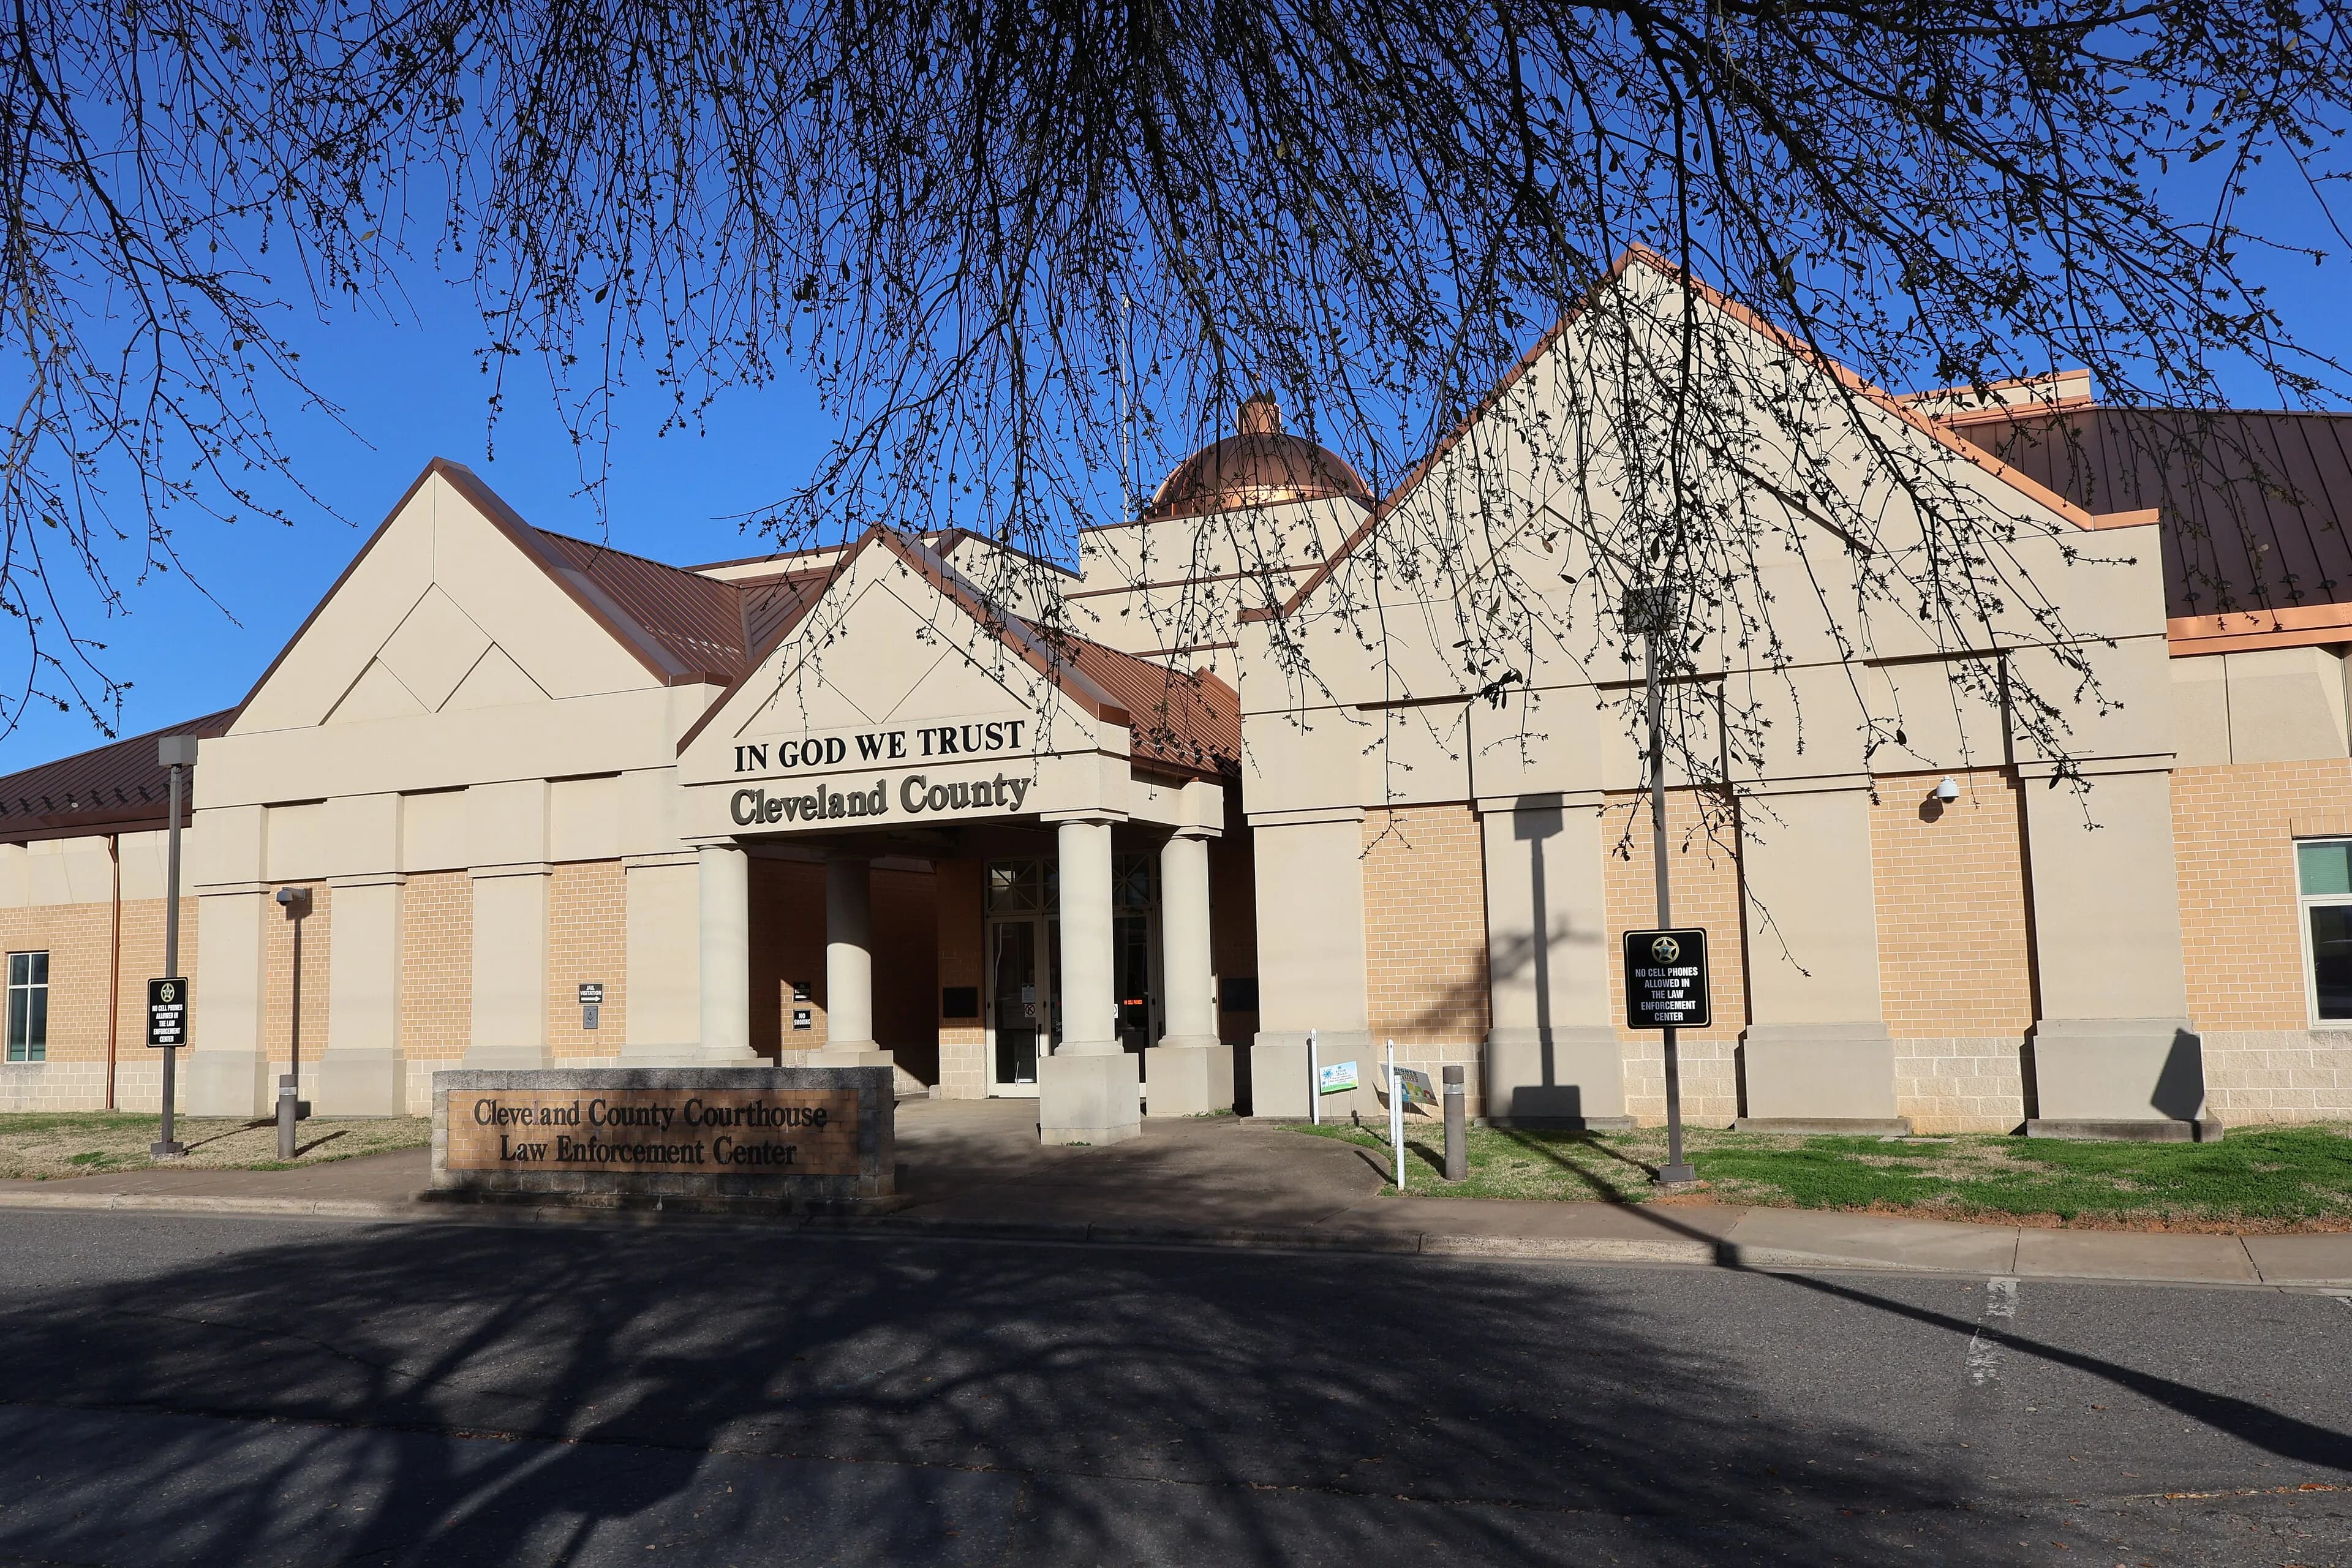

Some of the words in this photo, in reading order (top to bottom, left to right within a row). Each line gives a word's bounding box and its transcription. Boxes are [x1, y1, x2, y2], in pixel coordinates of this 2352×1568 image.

[734, 744, 769, 772] IN
[778, 737, 846, 768] GOD
[855, 731, 907, 761] WE
[917, 720, 1025, 756] TRUST
[731, 778, 889, 826] Cleveland
[900, 772, 1031, 813] County
[1635, 968, 1646, 977] NO
[1648, 968, 1665, 977] CELL
[1667, 967, 1698, 976] PHONES
[1645, 979, 1679, 988] ALLOWED
[1681, 978, 1690, 987] IN
[1651, 990, 1665, 999] THE
[1667, 990, 1684, 998] LAW
[1641, 1000, 1696, 1010] ENFORCEMENT
[1654, 1012, 1684, 1021] CENTER
[474, 1099, 581, 1126] Cleveland
[589, 1099, 675, 1132] County
[684, 1098, 827, 1127] Courthouse
[500, 1135, 548, 1161] Law
[556, 1136, 704, 1164] Enforcement
[714, 1136, 797, 1164] Center
